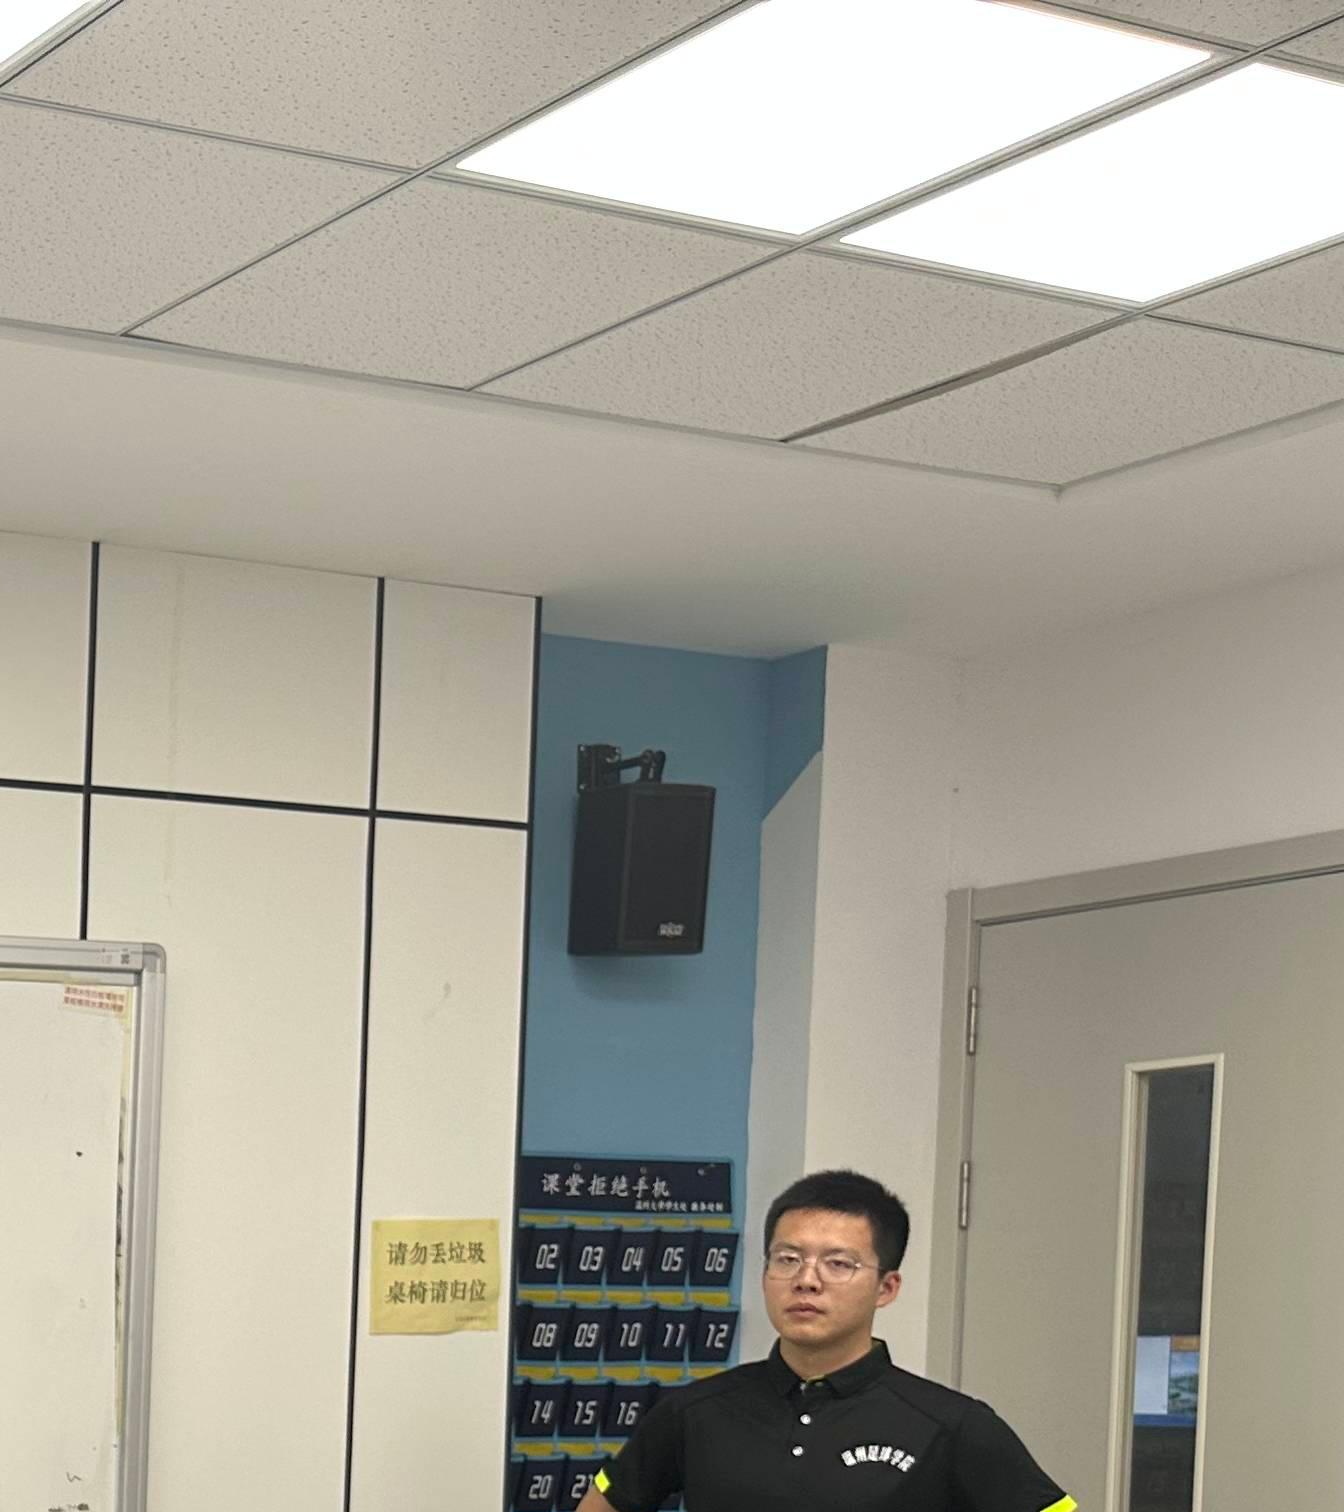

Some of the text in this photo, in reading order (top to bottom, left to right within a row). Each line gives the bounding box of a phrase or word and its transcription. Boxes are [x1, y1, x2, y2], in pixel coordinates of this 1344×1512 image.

[541, 1173, 670, 1199] 课堂拒绝手机
[386, 1241, 486, 1265] 请勿丢垃圾
[536, 1244, 728, 1272] 02 03 04 05 06
[384, 1279, 487, 1304] 桌椅请归位
[533, 1323, 728, 1347] 08 09 10 11 12
[532, 1401, 639, 1424] 14 15 16
[529, 1475, 552, 1498] 20
